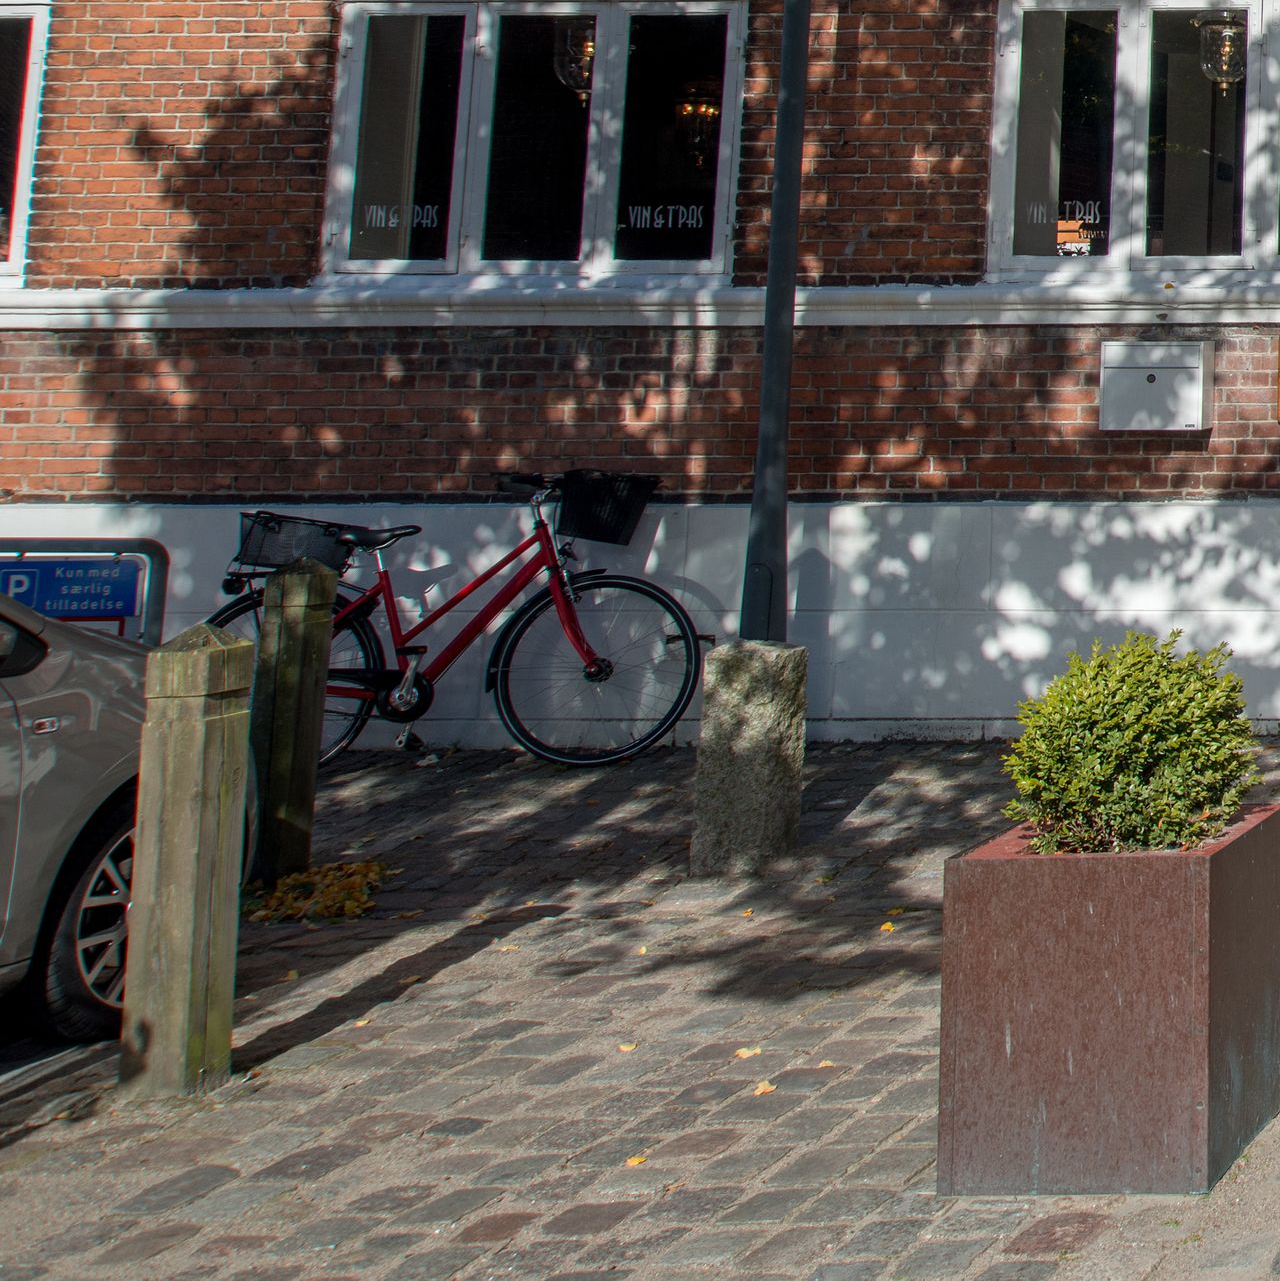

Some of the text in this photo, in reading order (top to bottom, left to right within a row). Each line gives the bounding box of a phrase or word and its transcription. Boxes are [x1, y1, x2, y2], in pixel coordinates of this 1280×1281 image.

[364, 205, 387, 228] VIN
[388, 205, 399, 227] &
[628, 205, 652, 228] VIN
[653, 205, 665, 228] &
[1024, 200, 1048, 224] VIN
[55, 567, 120, 578] Kun med
[8, 574, 29, 598] P
[61, 583, 112, 595] særlig
[45, 599, 125, 610] tilladelse
